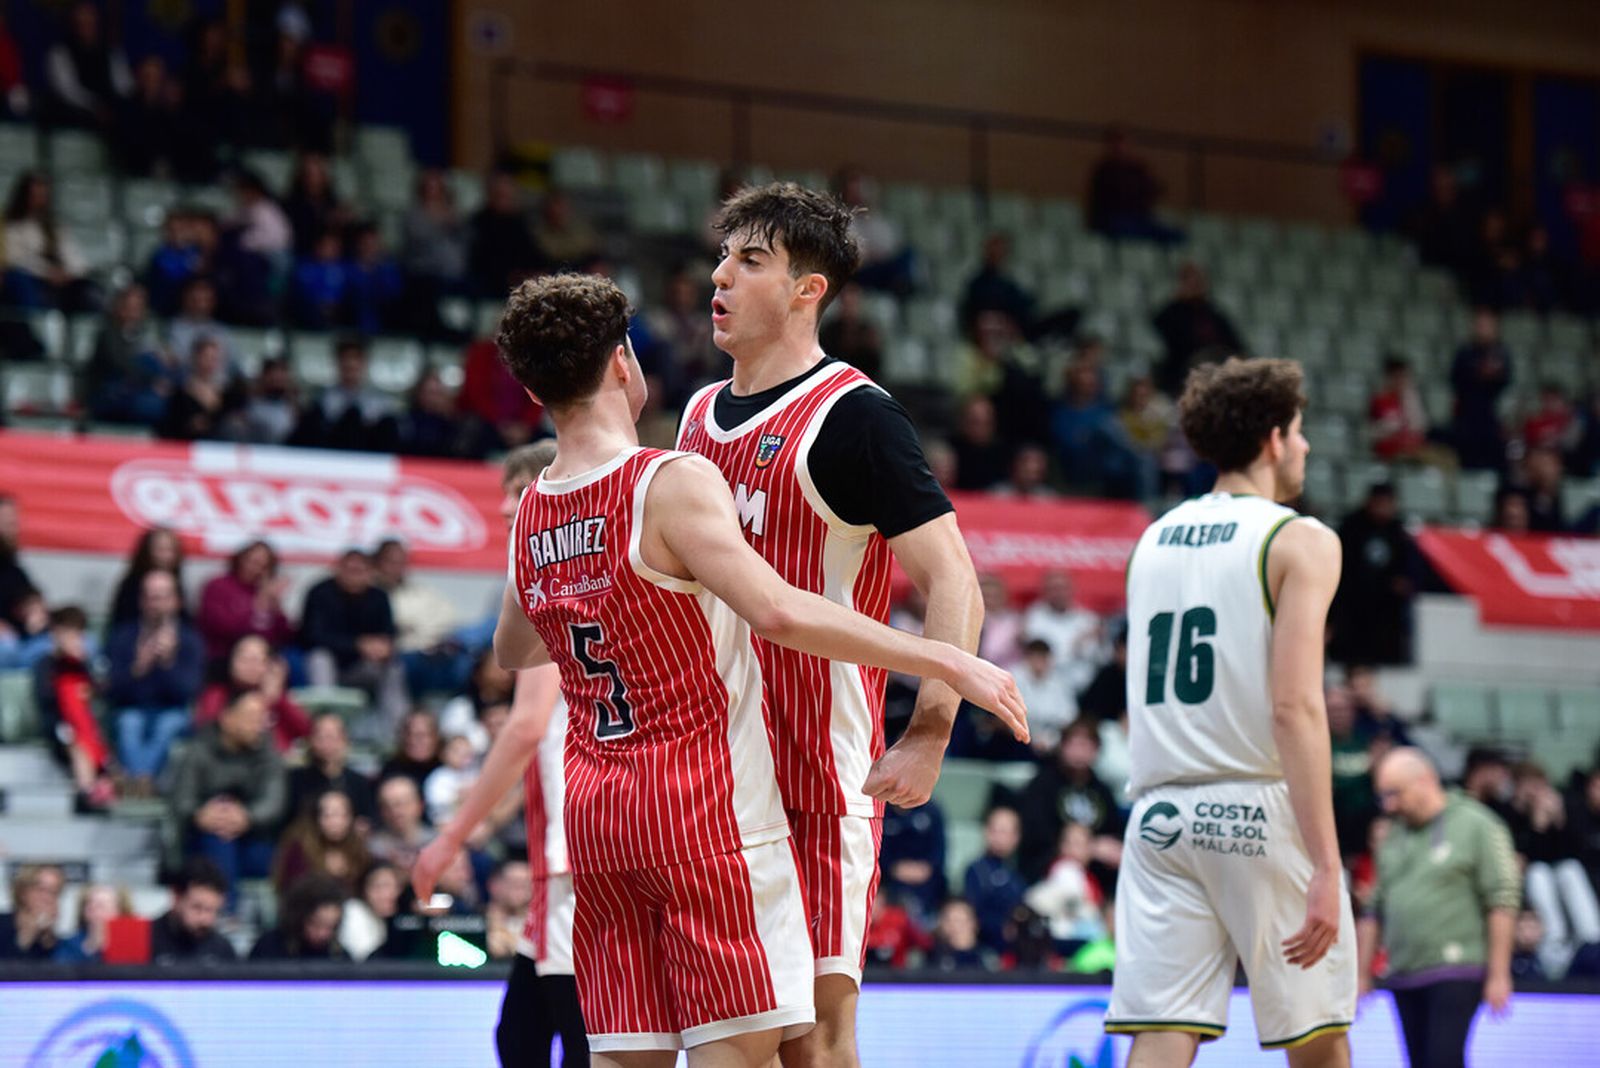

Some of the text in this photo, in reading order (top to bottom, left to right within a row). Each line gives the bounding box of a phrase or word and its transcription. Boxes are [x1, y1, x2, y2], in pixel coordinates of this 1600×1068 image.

[1157, 521, 1238, 547] VALERO
[549, 569, 612, 597] CaixaBank
[1145, 606, 1217, 705] 16
[567, 621, 636, 742] 5
[1195, 802, 1267, 823] COSTA
[1192, 821, 1267, 841] DEL SOL
